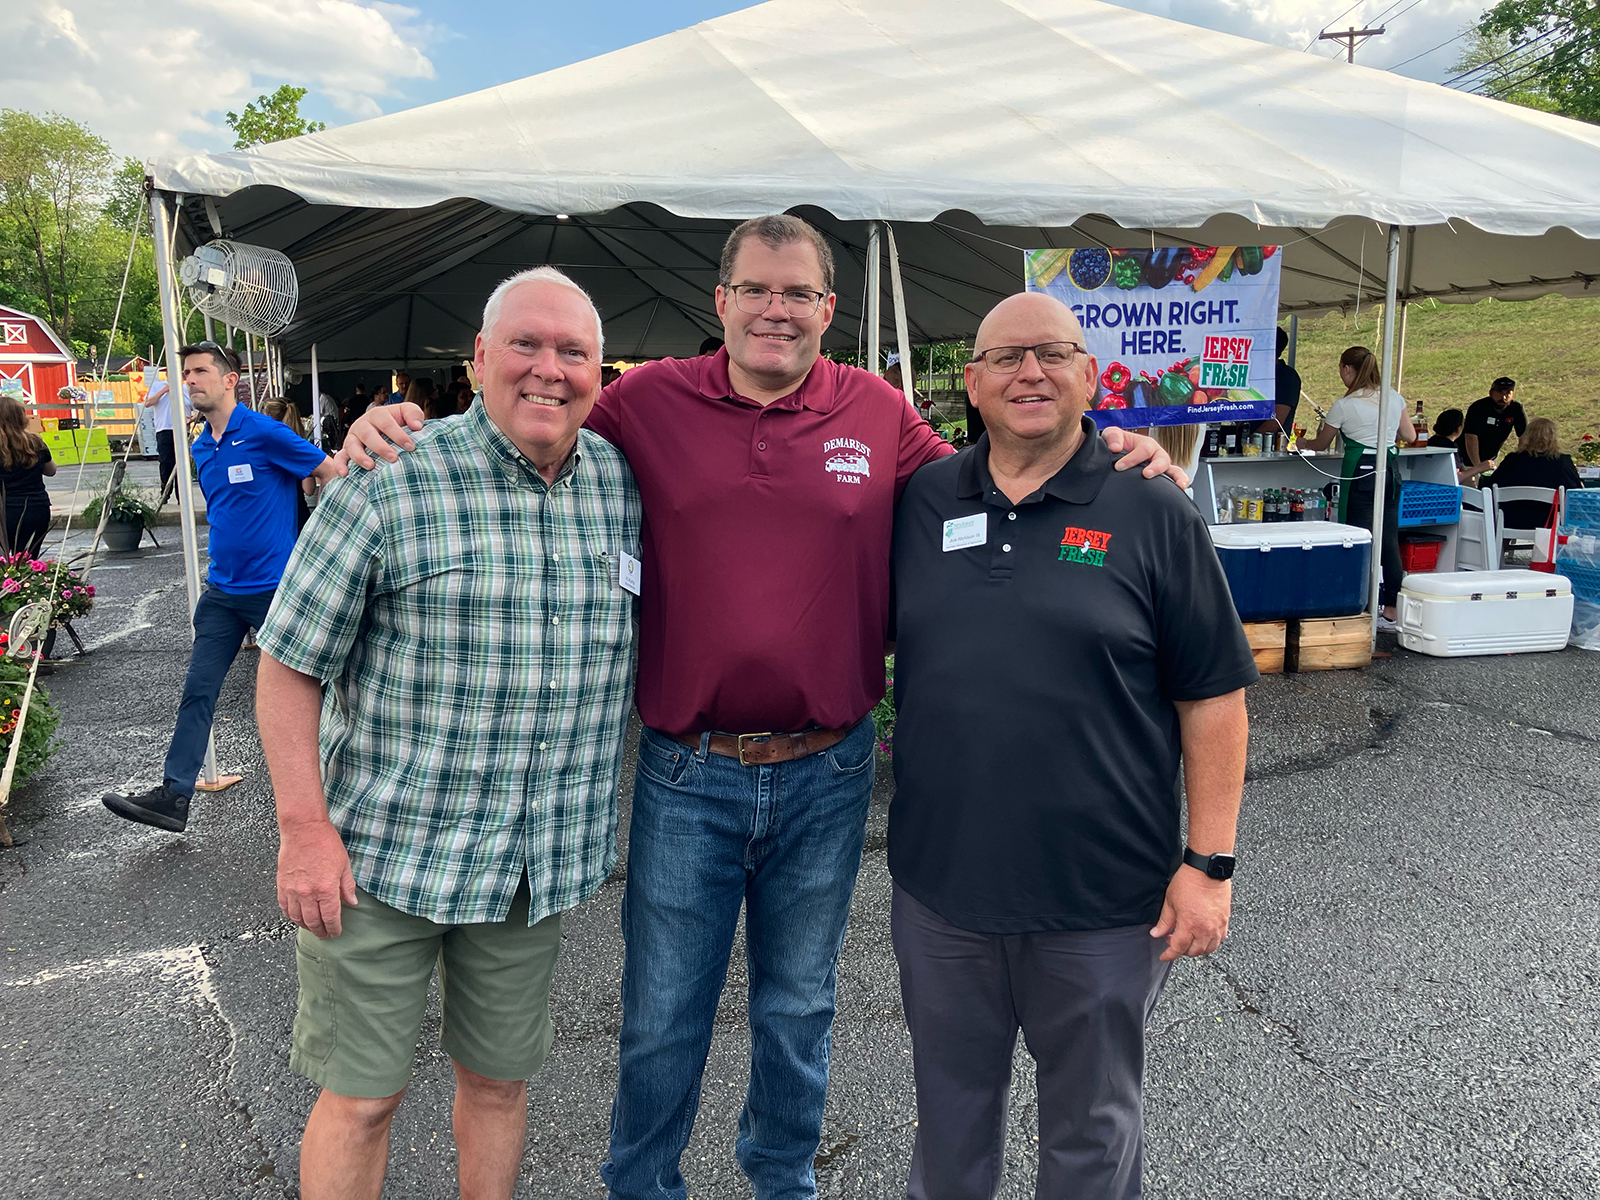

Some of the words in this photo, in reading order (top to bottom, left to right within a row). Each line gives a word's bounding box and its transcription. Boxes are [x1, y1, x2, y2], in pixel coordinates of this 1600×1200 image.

[1169, 300, 1240, 326] RIGHT.
[1121, 330, 1186, 355] HERE.
[1203, 336, 1252, 360] JERSEY
[1202, 363, 1249, 387] FRESH
[1187, 403, 1254, 414] FindJerseyFresh.com
[823, 438, 871, 457] DEMAREST
[836, 474, 861, 484] FARM
[1061, 526, 1112, 549] JERSEY
[1057, 545, 1106, 567] FRESH
